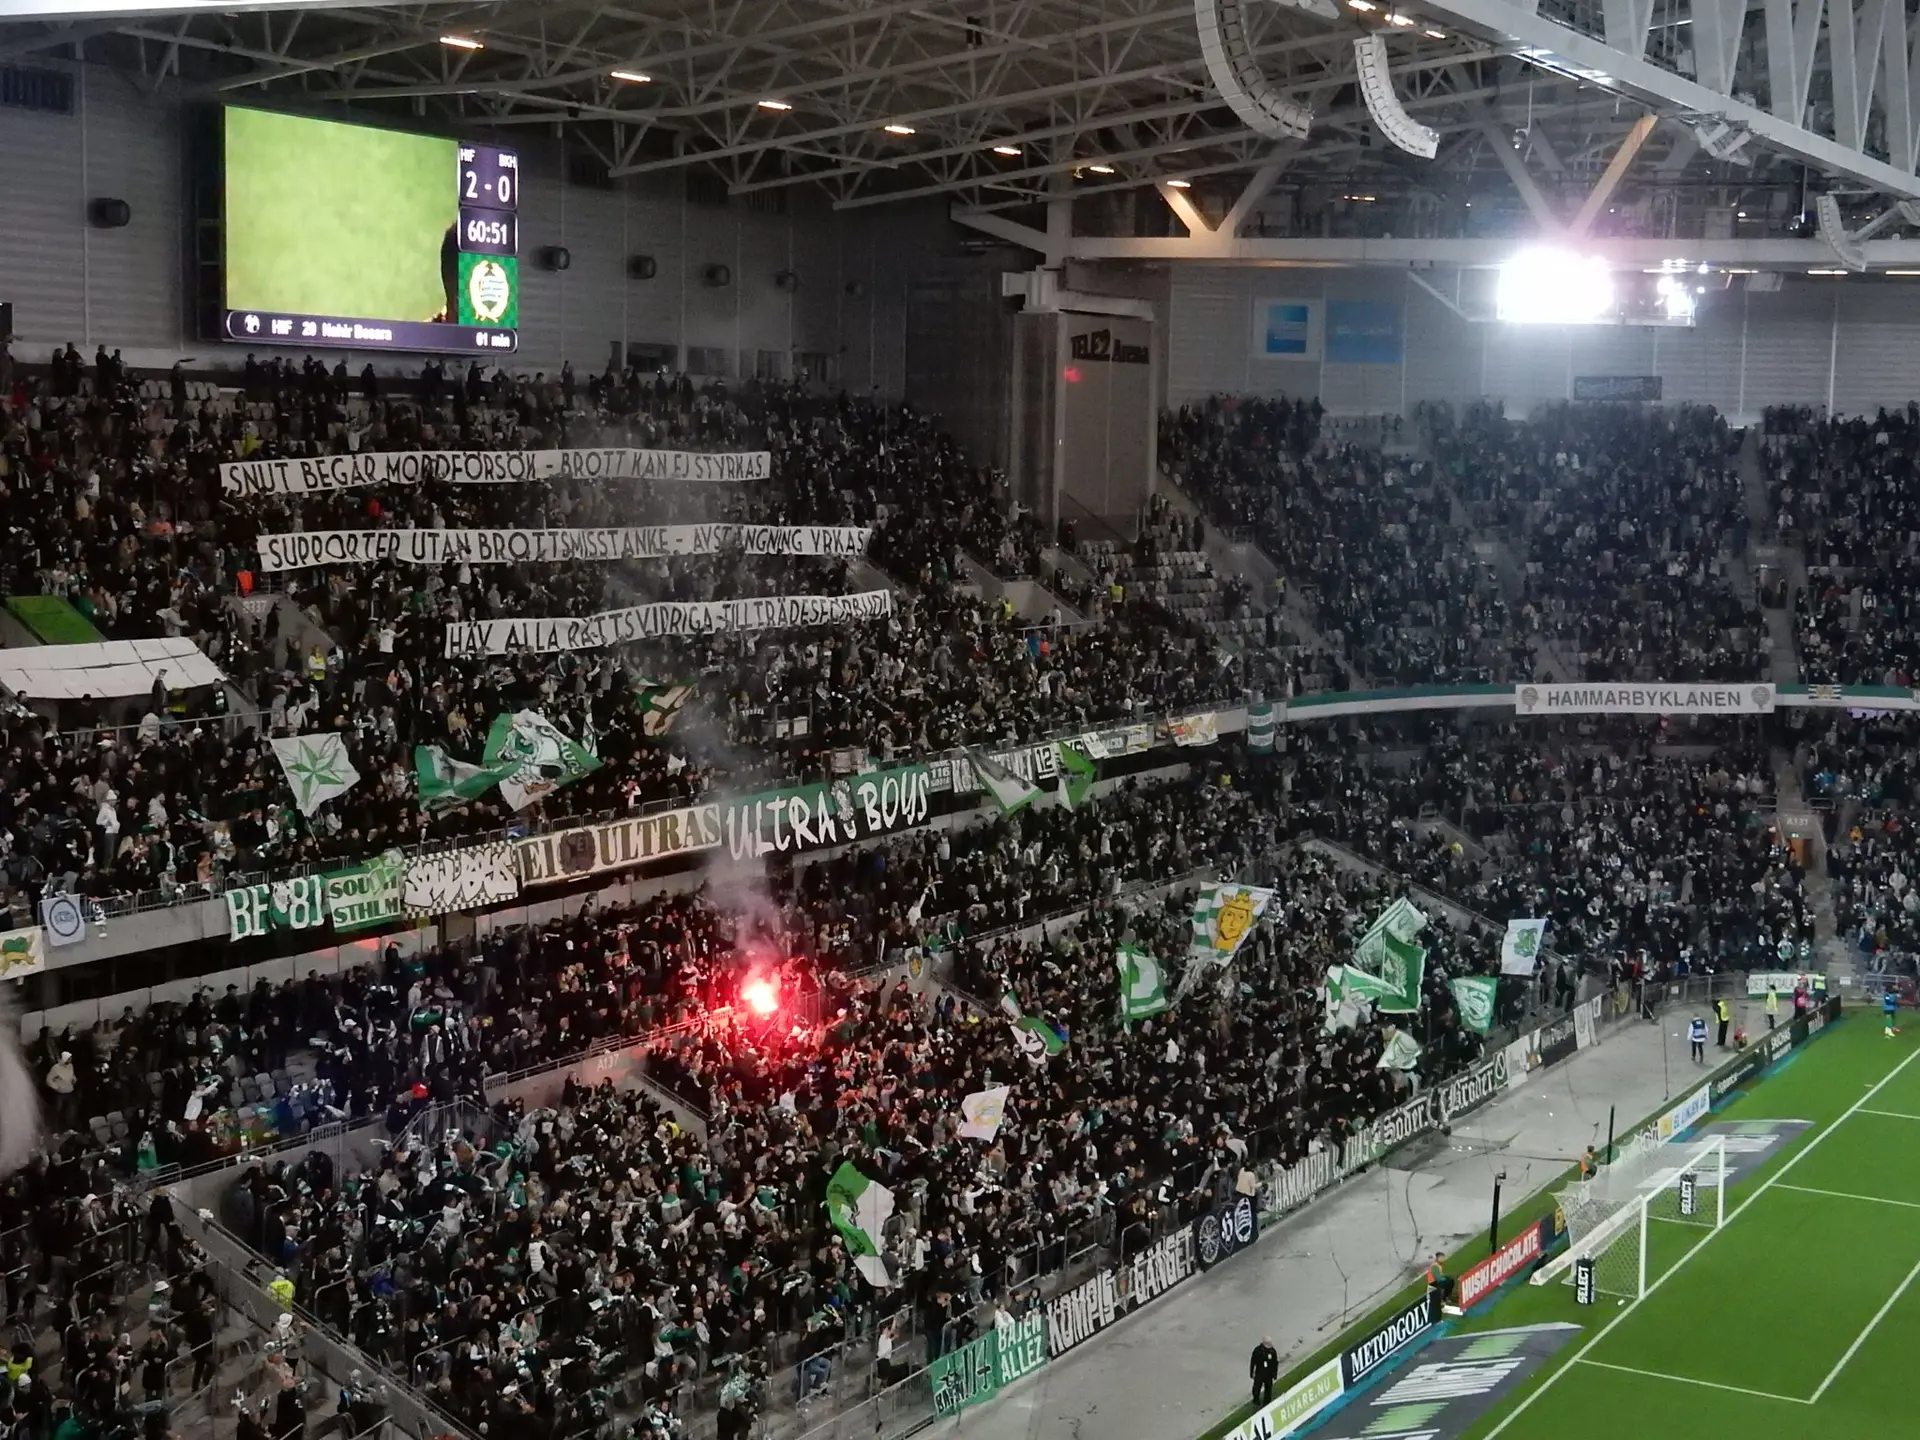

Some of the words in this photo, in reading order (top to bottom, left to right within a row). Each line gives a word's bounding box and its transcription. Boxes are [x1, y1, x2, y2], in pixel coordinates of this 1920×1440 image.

[460, 148, 476, 162] HIF
[466, 170, 479, 199] 2
[498, 175, 511, 203] 0
[467, 219, 508, 246] 60:51
[1070, 328, 1110, 362] TELE2
[229, 462, 292, 496] SNUT
[300, 453, 377, 492] BEGÅR
[560, 450, 627, 478] BROTT
[631, 452, 667, 478] KAN
[673, 453, 690, 478] EJ
[267, 531, 400, 569] SUPPORTER
[412, 531, 472, 561] UTAN
[478, 528, 668, 560] BROTTSMISSTANKE
[810, 528, 865, 554] YRKAS
[450, 621, 493, 653] HÄV
[504, 621, 561, 652] ALLA
[1547, 690, 1742, 706] HAMMARBYKLANEN
[1036, 746, 1053, 771] 12
[856, 769, 930, 832] BOYS
[597, 804, 720, 867] ULTRAS
[288, 874, 325, 930] 81
[333, 896, 400, 924] STHLM
[1681, 1180, 1692, 1215] SELECT
[1461, 1263, 1490, 1305] HUSKI
[1490, 1228, 1539, 1283] CHOCOLATE
[1577, 1265, 1589, 1305] SELECT
[998, 1308, 1042, 1353] BAJEN
[1046, 1268, 1116, 1356] KOMPIS
[1000, 1334, 1046, 1383] ALLEZ
[1350, 1299, 1431, 1378] METODGOLV
[1280, 1376, 1332, 1423] RIVARE.NU
